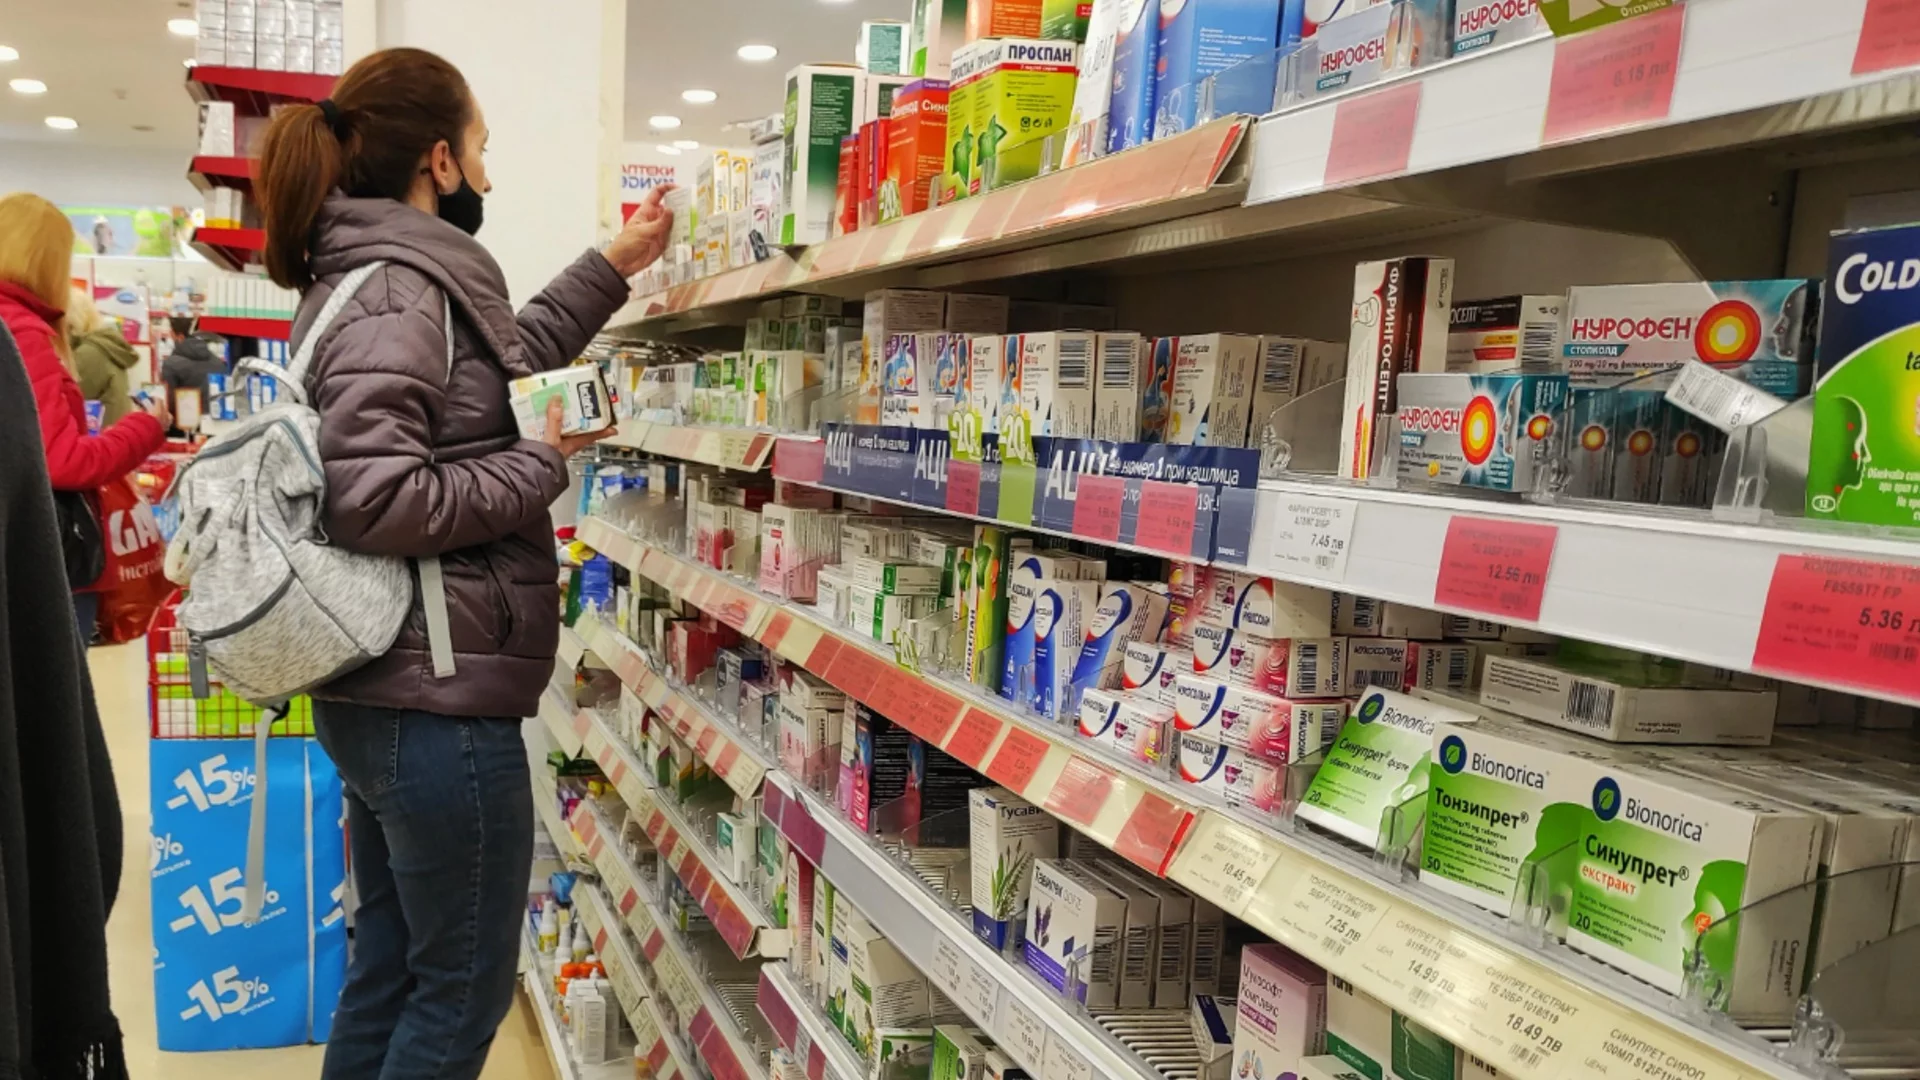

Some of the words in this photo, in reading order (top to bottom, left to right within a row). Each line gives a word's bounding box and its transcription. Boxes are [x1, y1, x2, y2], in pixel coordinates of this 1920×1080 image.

[1007, 44, 1072, 62] ПРОСПАН
[1320, 37, 1385, 74] НУРОФЕН
[1378, 266, 1400, 410] ФАРИНГОСЕПТ
[1572, 316, 1692, 341] НУРОФЕН
[1121, 460, 1155, 480] номер
[1164, 463, 1185, 483] при
[1185, 465, 1240, 488] кашлица
[1311, 532, 1330, 548] 7.45
[1489, 563, 1521, 582] 12.56
[1859, 607, 1904, 631] 5.36
[1382, 706, 1435, 736] Bionorica
[1471, 752, 1545, 790] Bionorica
[1308, 790, 1321, 803] 20
[1625, 797, 1703, 843] Bionorica
[1427, 855, 1441, 871] 50
[1581, 864, 1637, 896] екстракт
[1325, 913, 1346, 935] 7.25
[1576, 912, 1591, 930] 20
[1408, 959, 1438, 983] 14.99
[1486, 966, 1532, 994] СИНУПРЕТ
[1531, 989, 1579, 1017] ЕКСТРАКТ
[1488, 981, 1500, 997] ТБ
[1506, 1012, 1542, 1041] 18.49
[1610, 1028, 1667, 1061] СИНУПРЕТ
[1665, 1055, 1706, 1080] СИРОП
